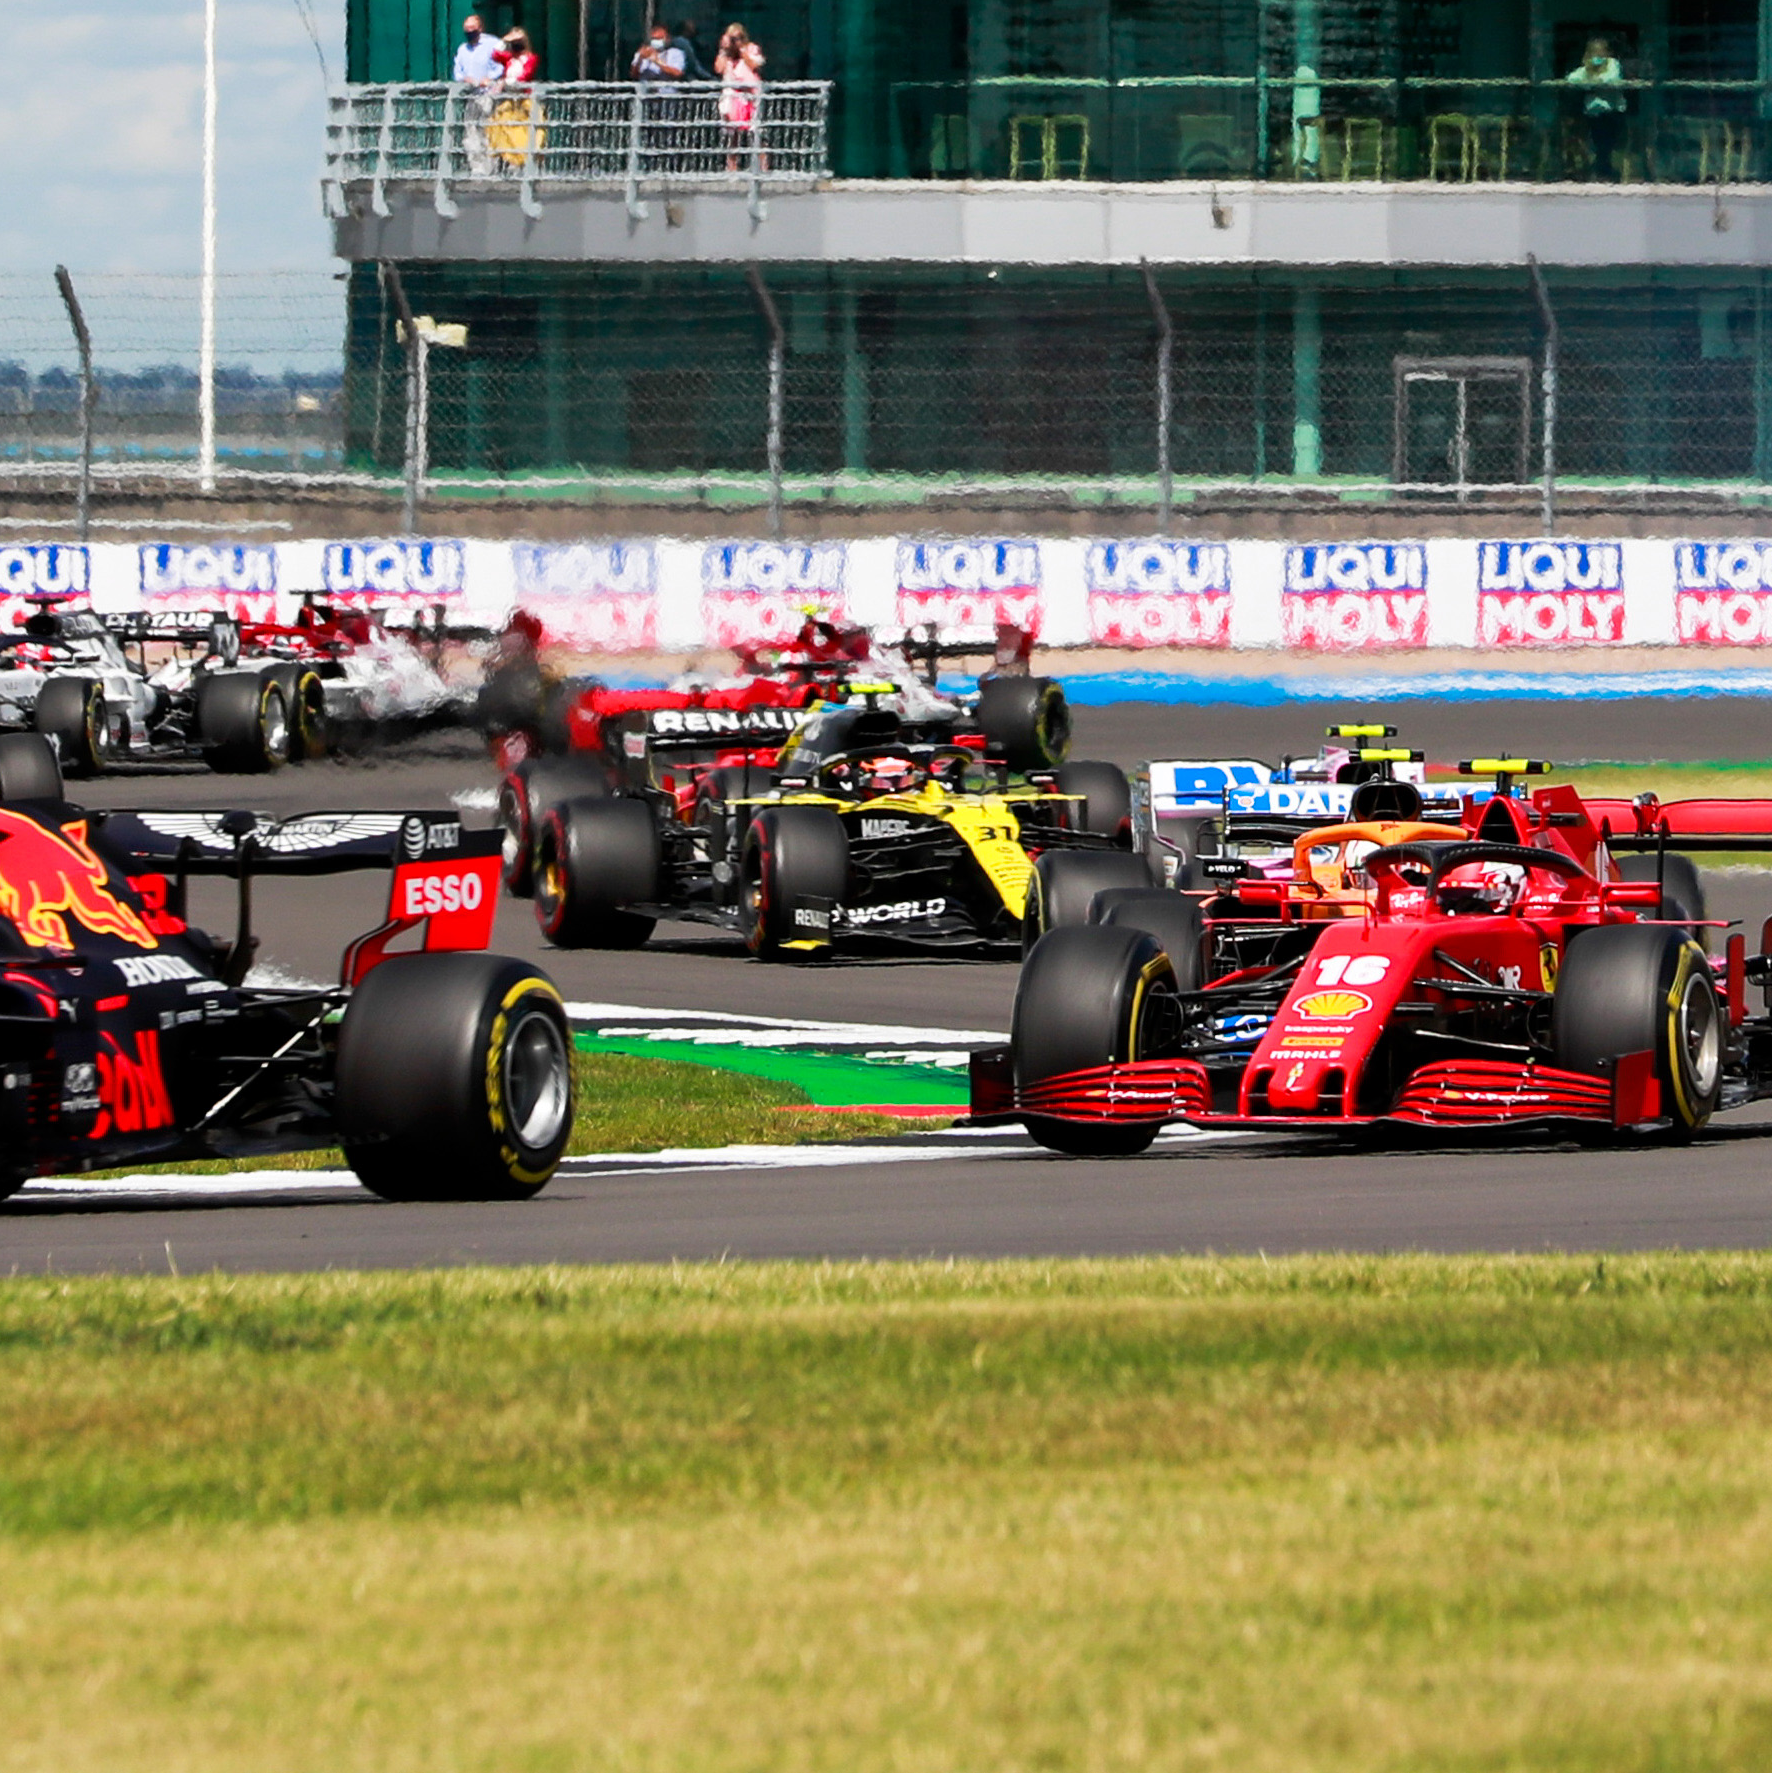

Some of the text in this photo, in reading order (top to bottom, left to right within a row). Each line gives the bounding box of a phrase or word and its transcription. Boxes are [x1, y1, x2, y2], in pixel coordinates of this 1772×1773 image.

[1288, 546, 1424, 592] LIQUI
[1483, 544, 1621, 591] LIQUI
[1287, 596, 1426, 644] MOLY
[1482, 596, 1623, 643] MOLY
[426, 823, 460, 850] AT&T
[979, 826, 1012, 842] 31
[405, 872, 483, 915] ESSO
[847, 898, 947, 925] WORLD
[1315, 955, 1391, 986] 16
[1270, 1050, 1342, 1060] MAHLE
